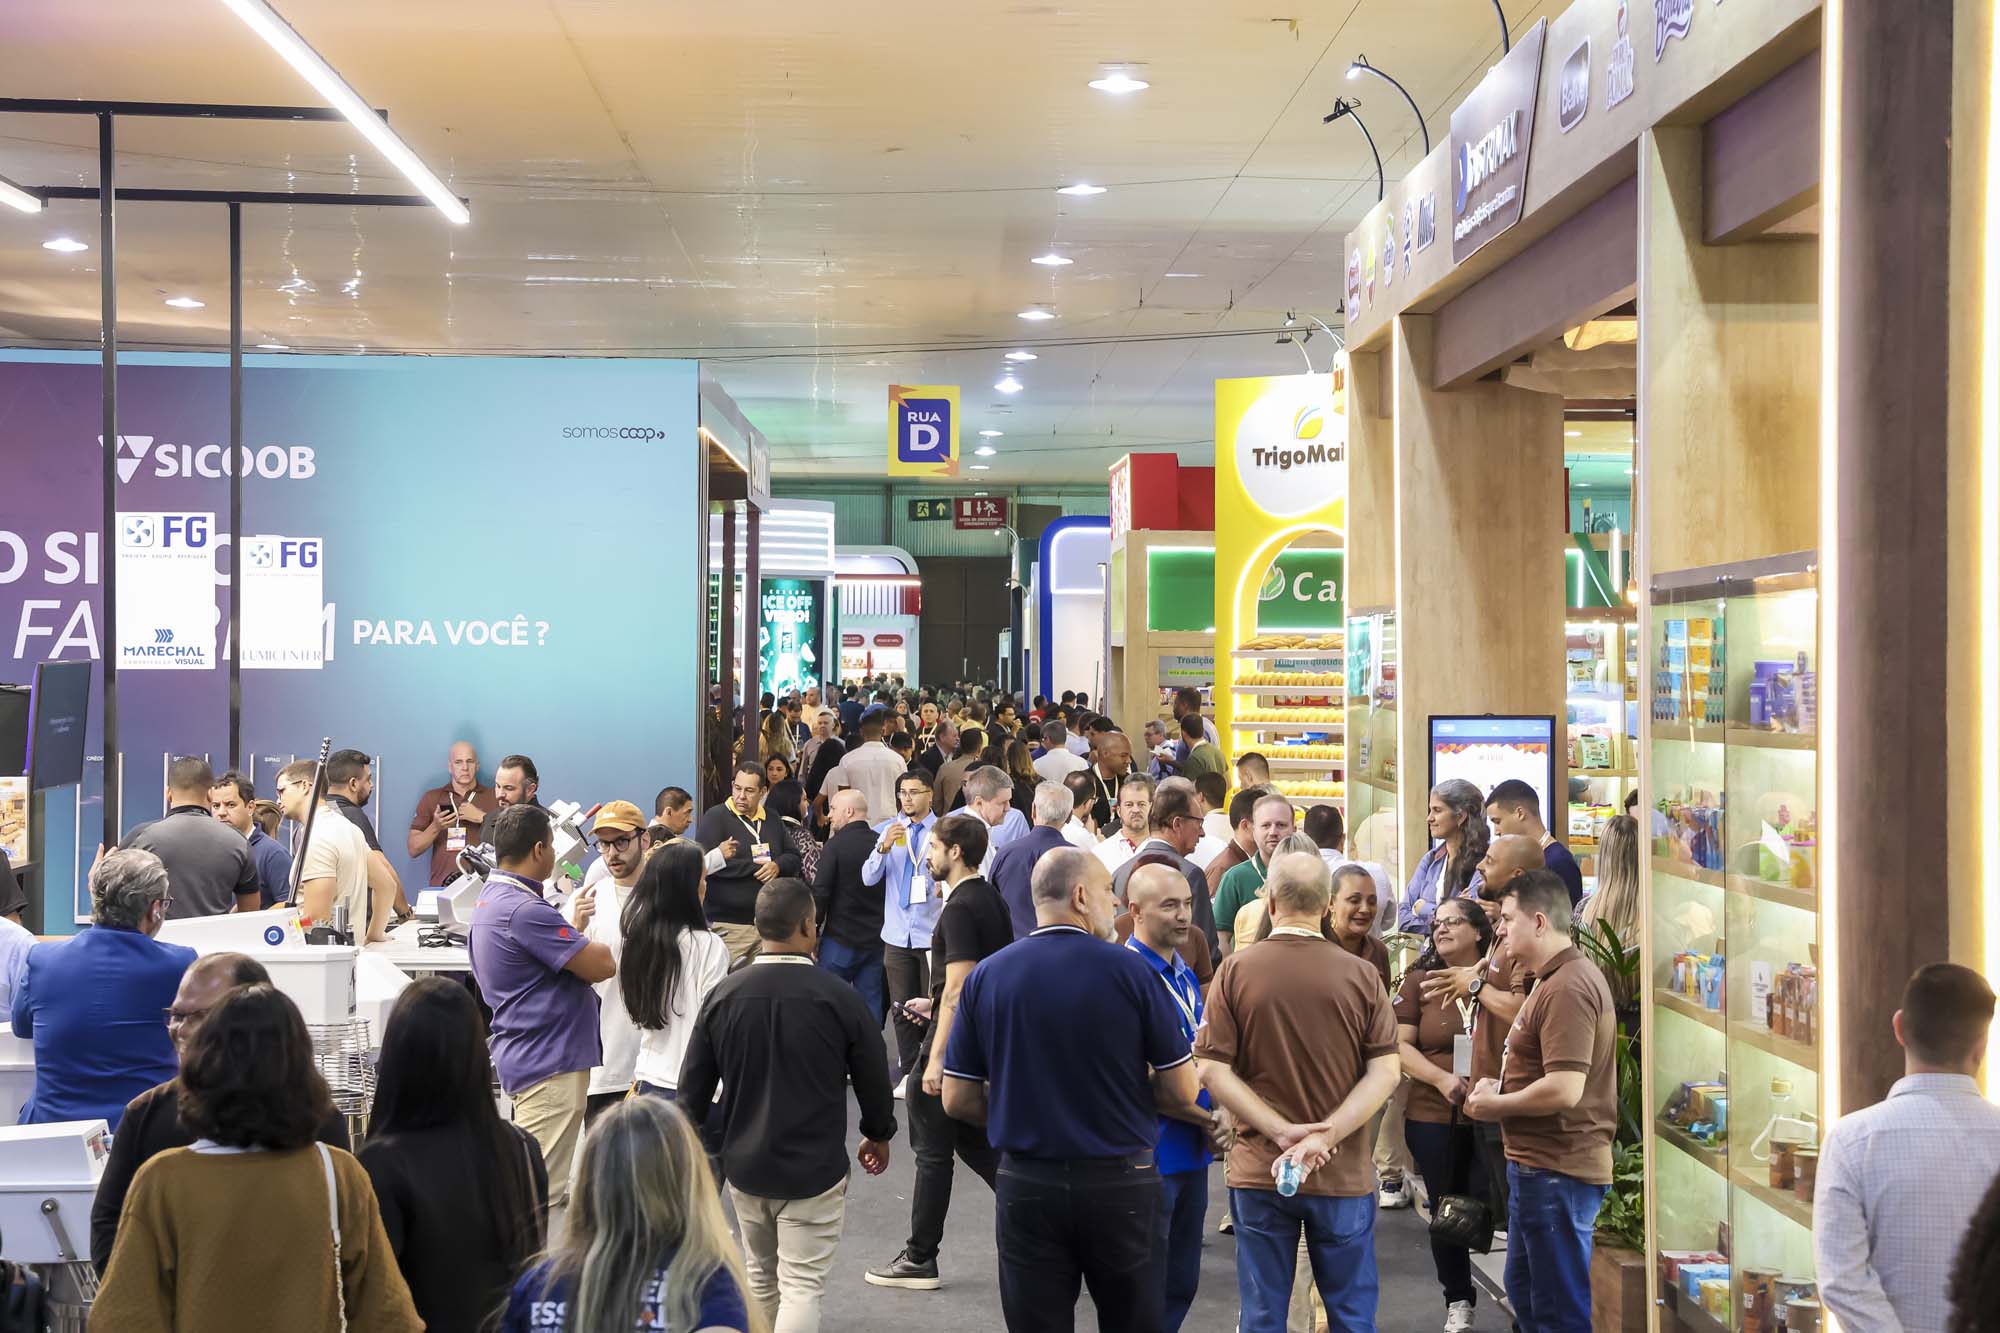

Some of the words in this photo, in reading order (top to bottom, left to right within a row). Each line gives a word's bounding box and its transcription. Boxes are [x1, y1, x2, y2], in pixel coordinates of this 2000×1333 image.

[908, 412, 941, 422] RUA
[910, 424, 939, 451] D
[155, 444, 316, 479] SICOOB
[163, 516, 207, 547] FG
[280, 541, 317, 568] FG
[1293, 571, 1344, 602] Ca
[786, 595, 812, 610] OFF
[353, 620, 438, 645] PARA
[443, 613, 529, 646] VOCÊ
[123, 646, 205, 656] MARECHAL
